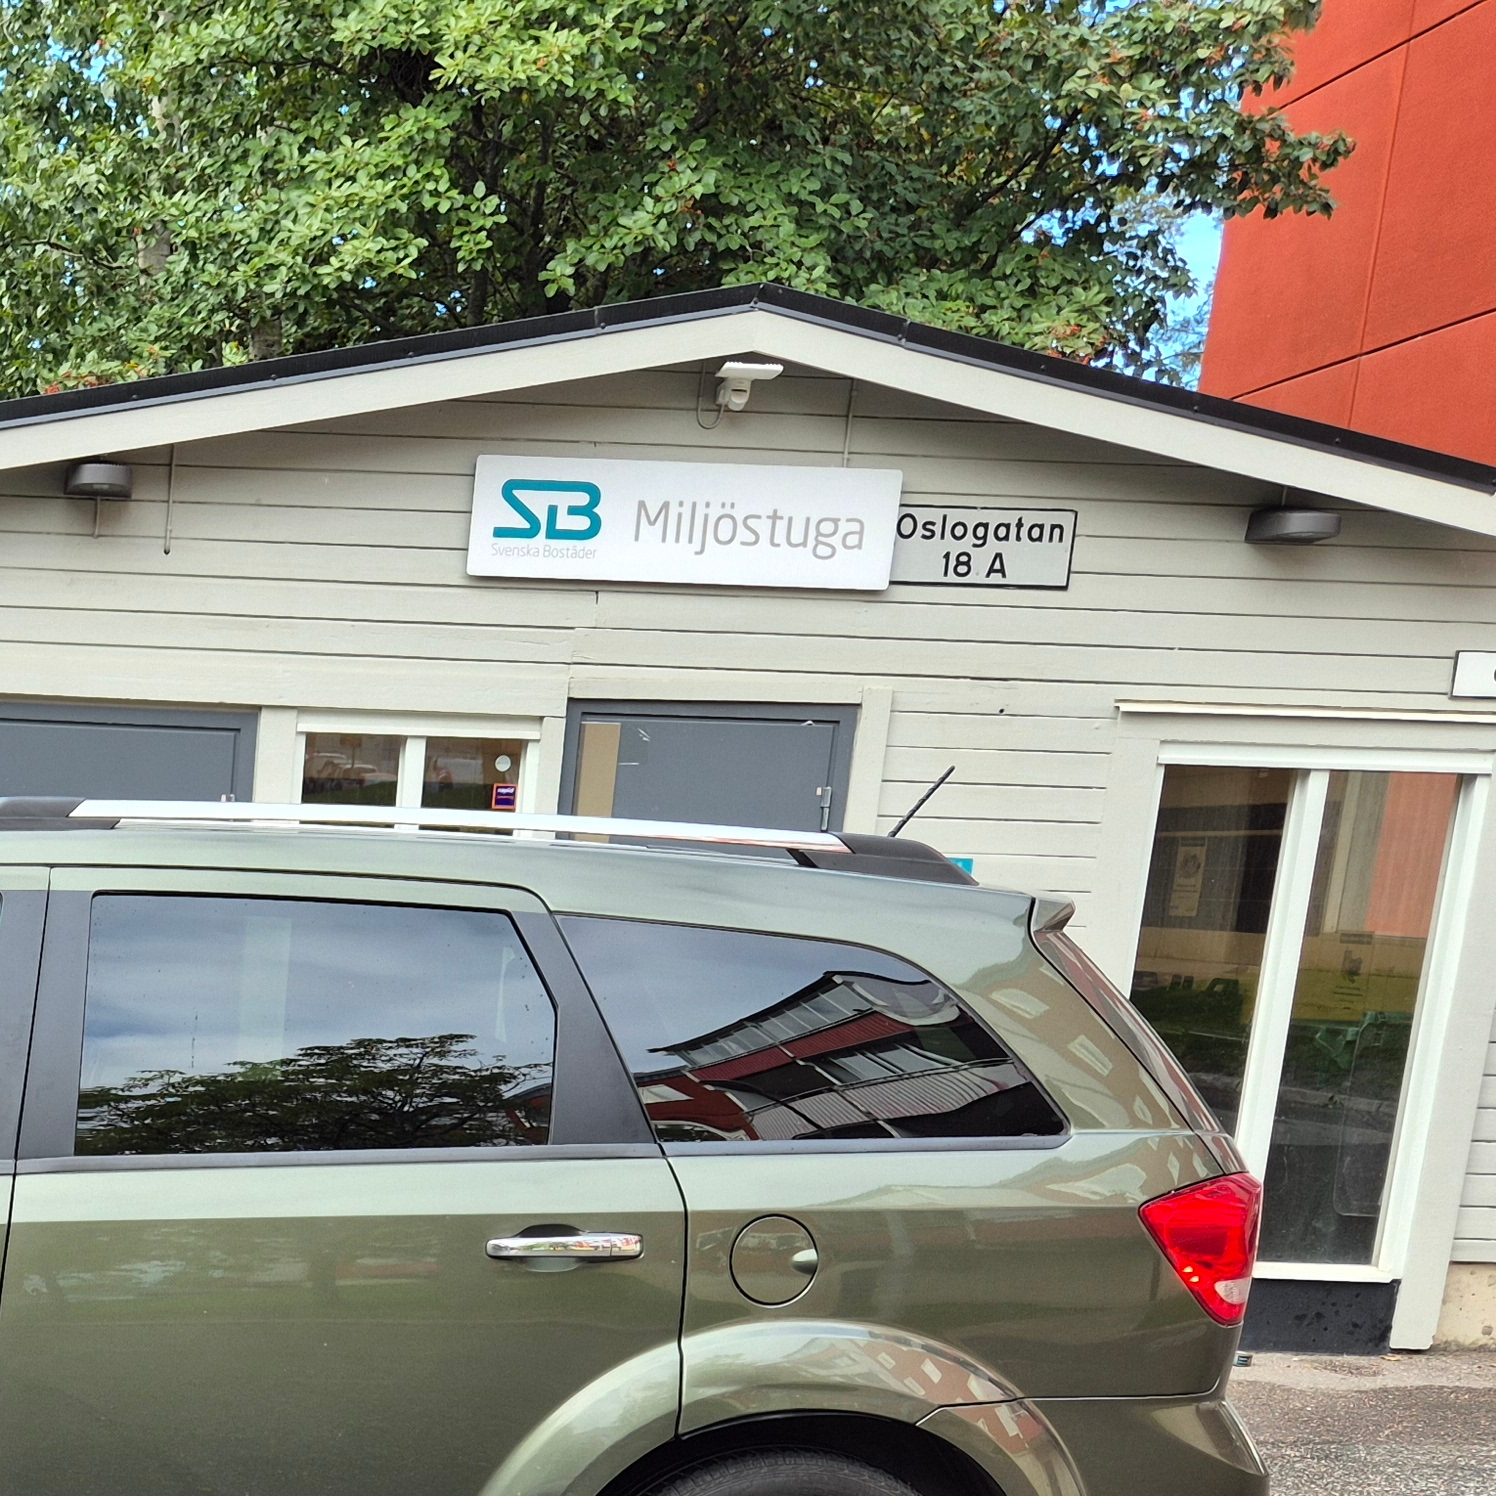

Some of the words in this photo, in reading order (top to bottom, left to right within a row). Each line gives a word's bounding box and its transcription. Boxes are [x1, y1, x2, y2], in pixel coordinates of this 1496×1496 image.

[634, 500, 865, 560] Miljöstuga
[896, 512, 1065, 548] Oslogatan
[491, 542, 540, 558] Svenska
[542, 544, 597, 560] Bostäder
[942, 551, 972, 578] 18
[985, 552, 1007, 579] A
